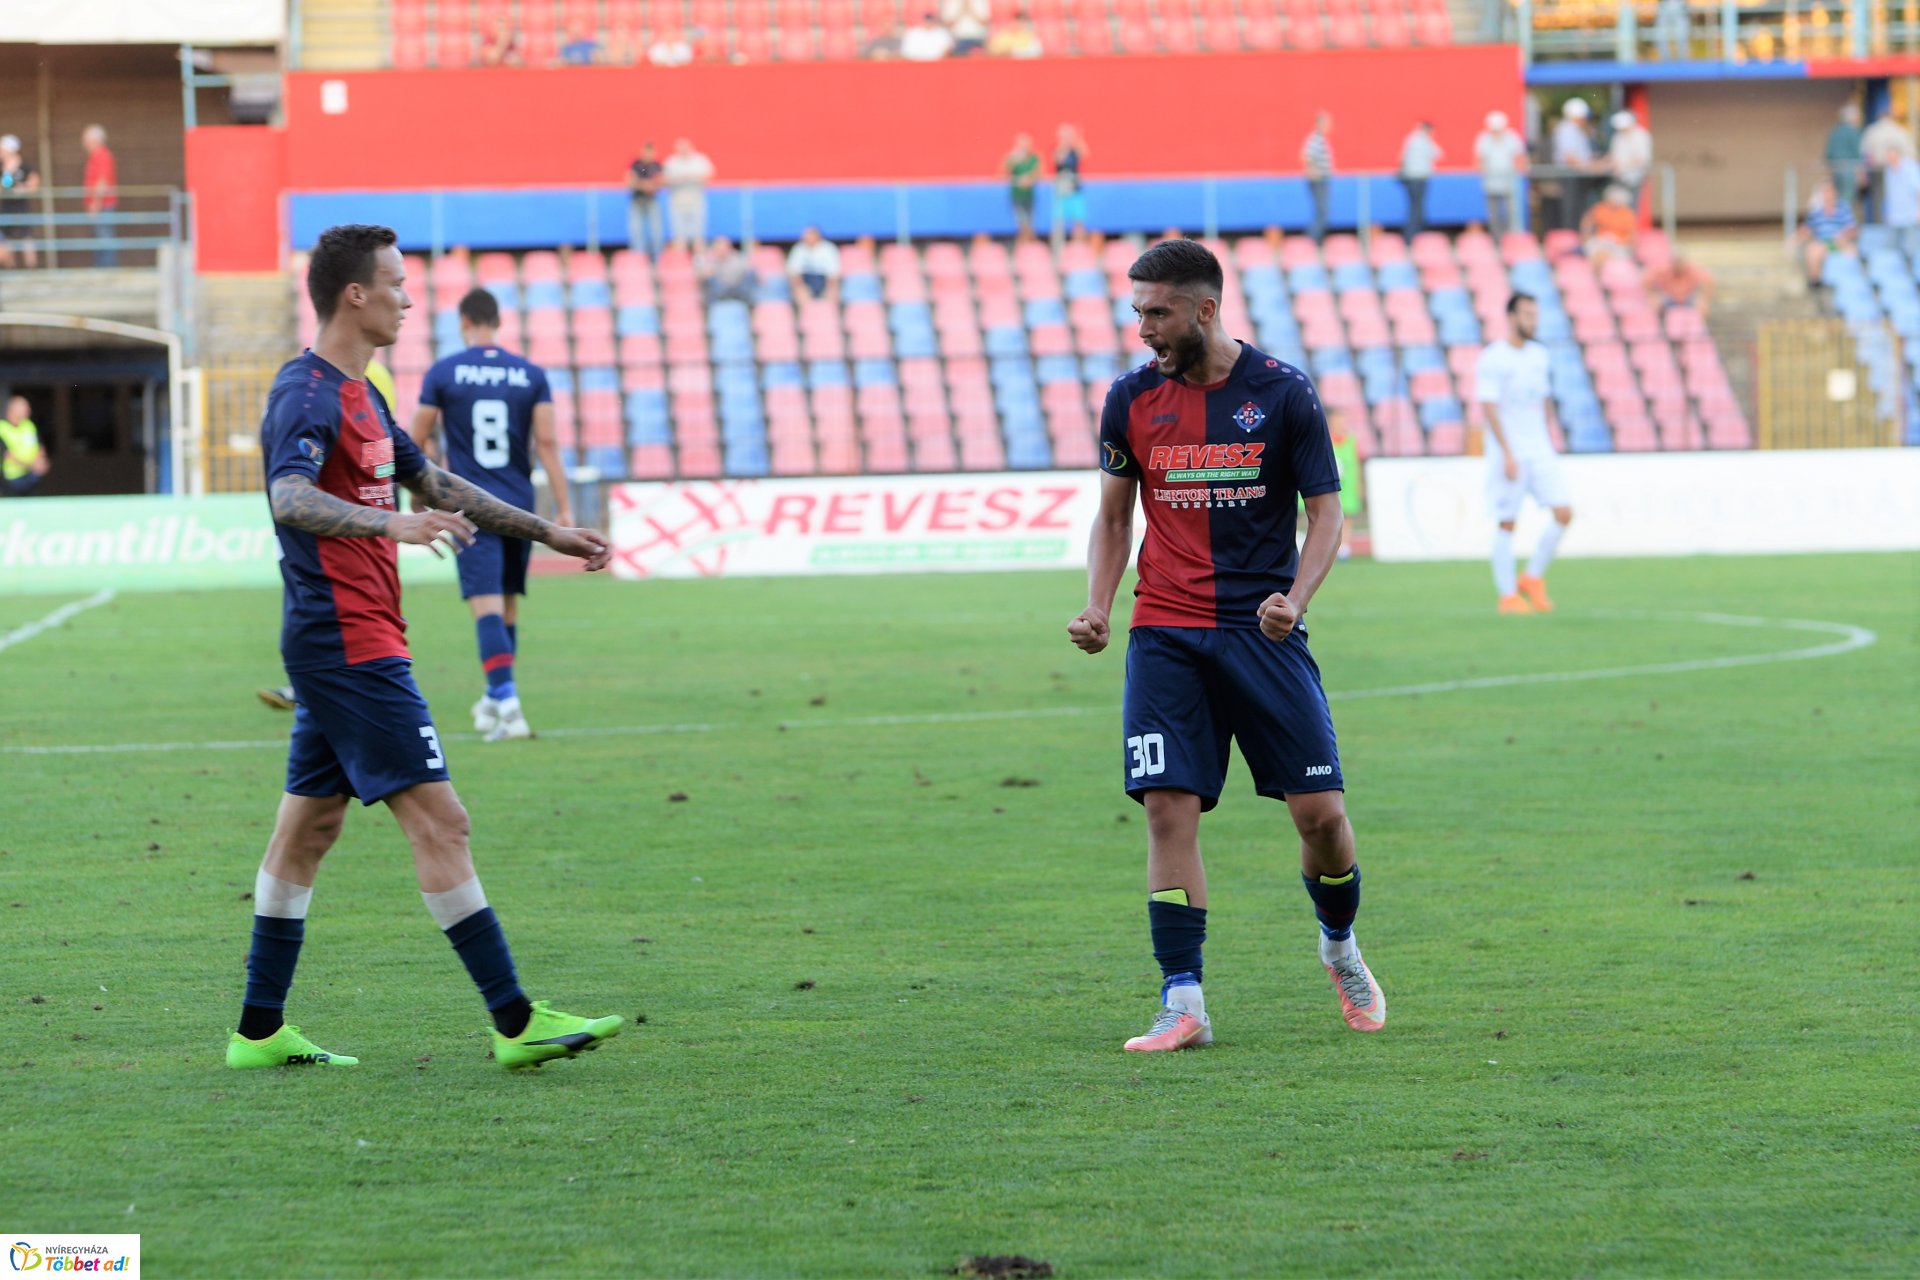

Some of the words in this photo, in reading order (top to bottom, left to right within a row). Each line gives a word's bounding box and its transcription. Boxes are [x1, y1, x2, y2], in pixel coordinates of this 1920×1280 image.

[472, 398, 510, 470] 8
[1149, 443, 1265, 469] REVESZ
[1168, 472, 1195, 480] ALWAYS
[1241, 469, 1258, 477] WAY
[1153, 488, 1211, 501] LERTON
[1213, 486, 1266, 500] TRANS
[1171, 500, 1247, 509] HUNGARY
[764, 486, 1079, 536] REVESZ
[418, 725, 444, 769] 3
[1127, 733, 1165, 779] 30
[1305, 765, 1333, 777] JAKO
